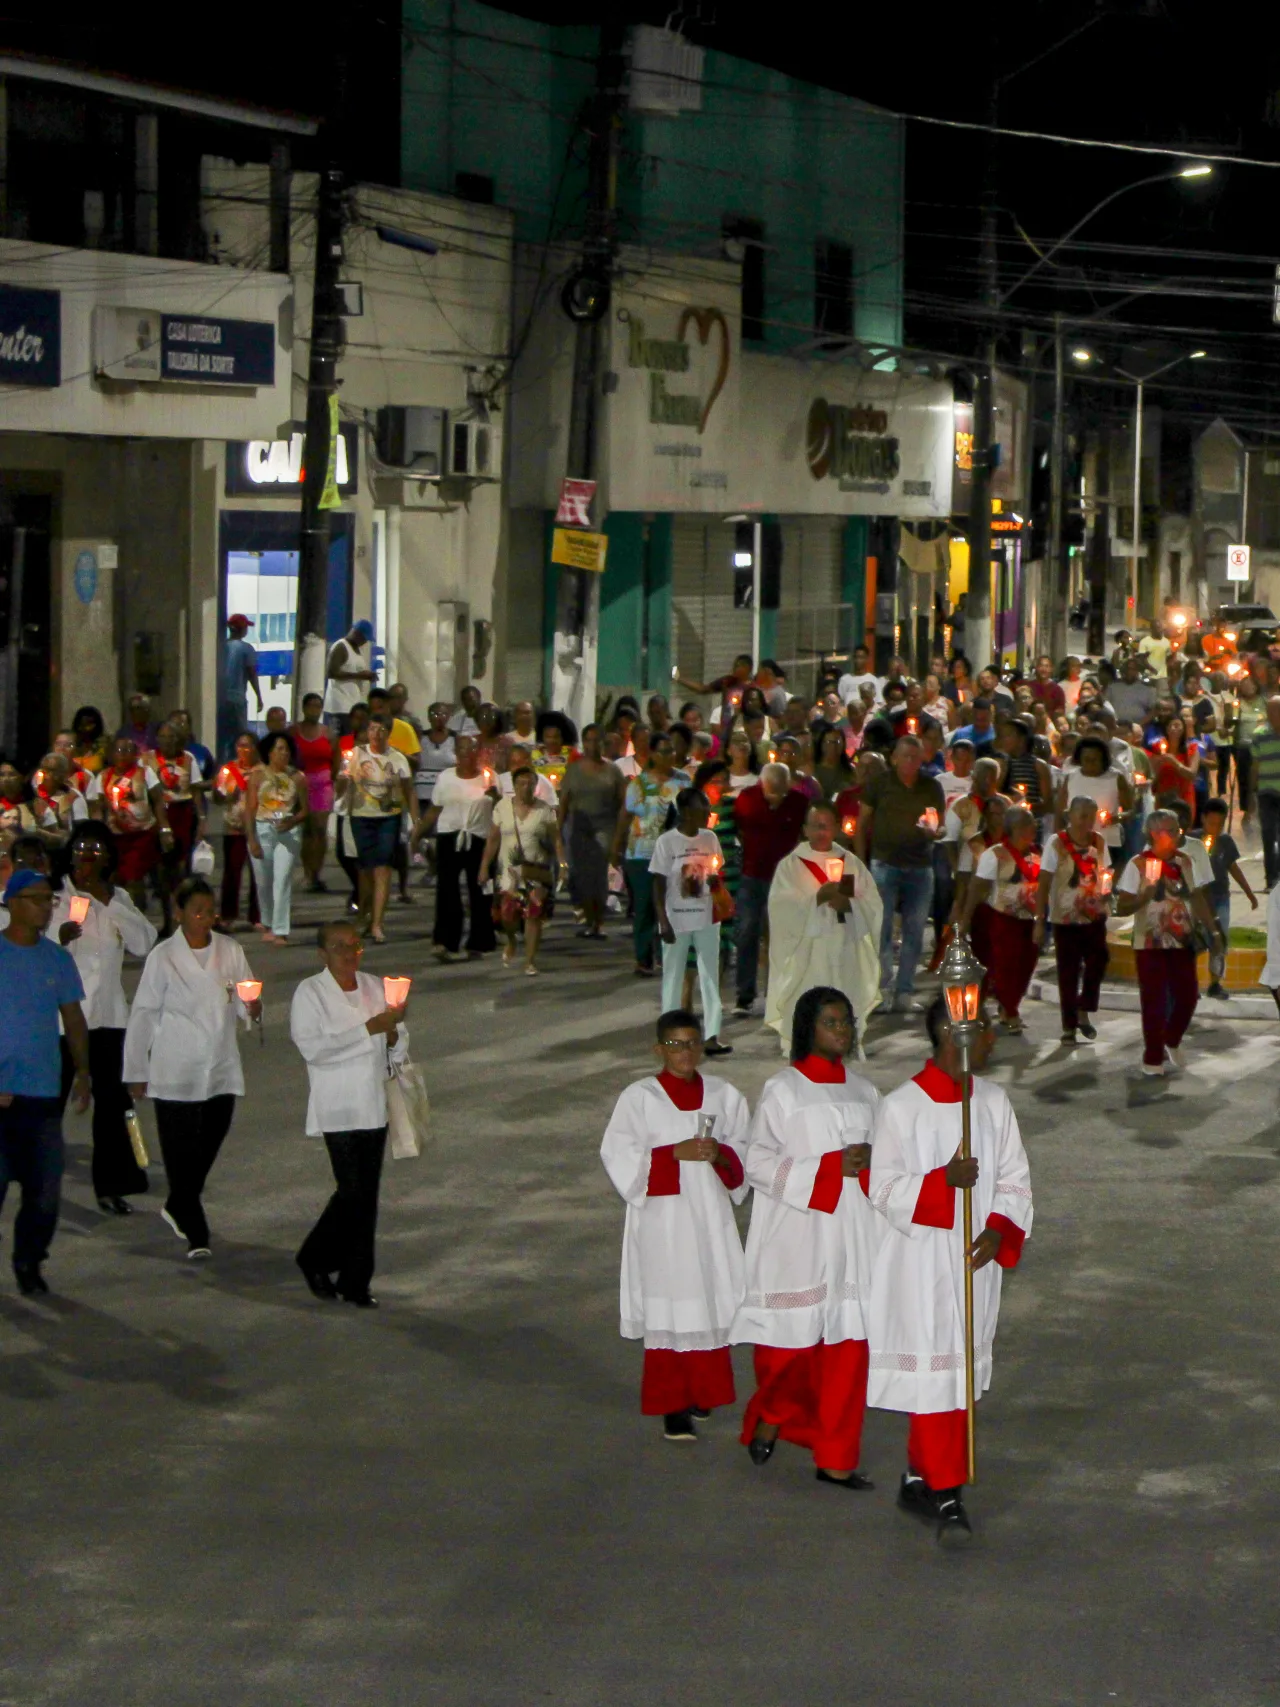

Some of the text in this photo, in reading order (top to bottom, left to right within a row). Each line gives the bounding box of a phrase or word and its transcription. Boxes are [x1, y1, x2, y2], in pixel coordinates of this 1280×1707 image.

[0, 326, 45, 362] nter
[167, 322, 187, 341] CASA
[247, 432, 349, 484] CAIA
